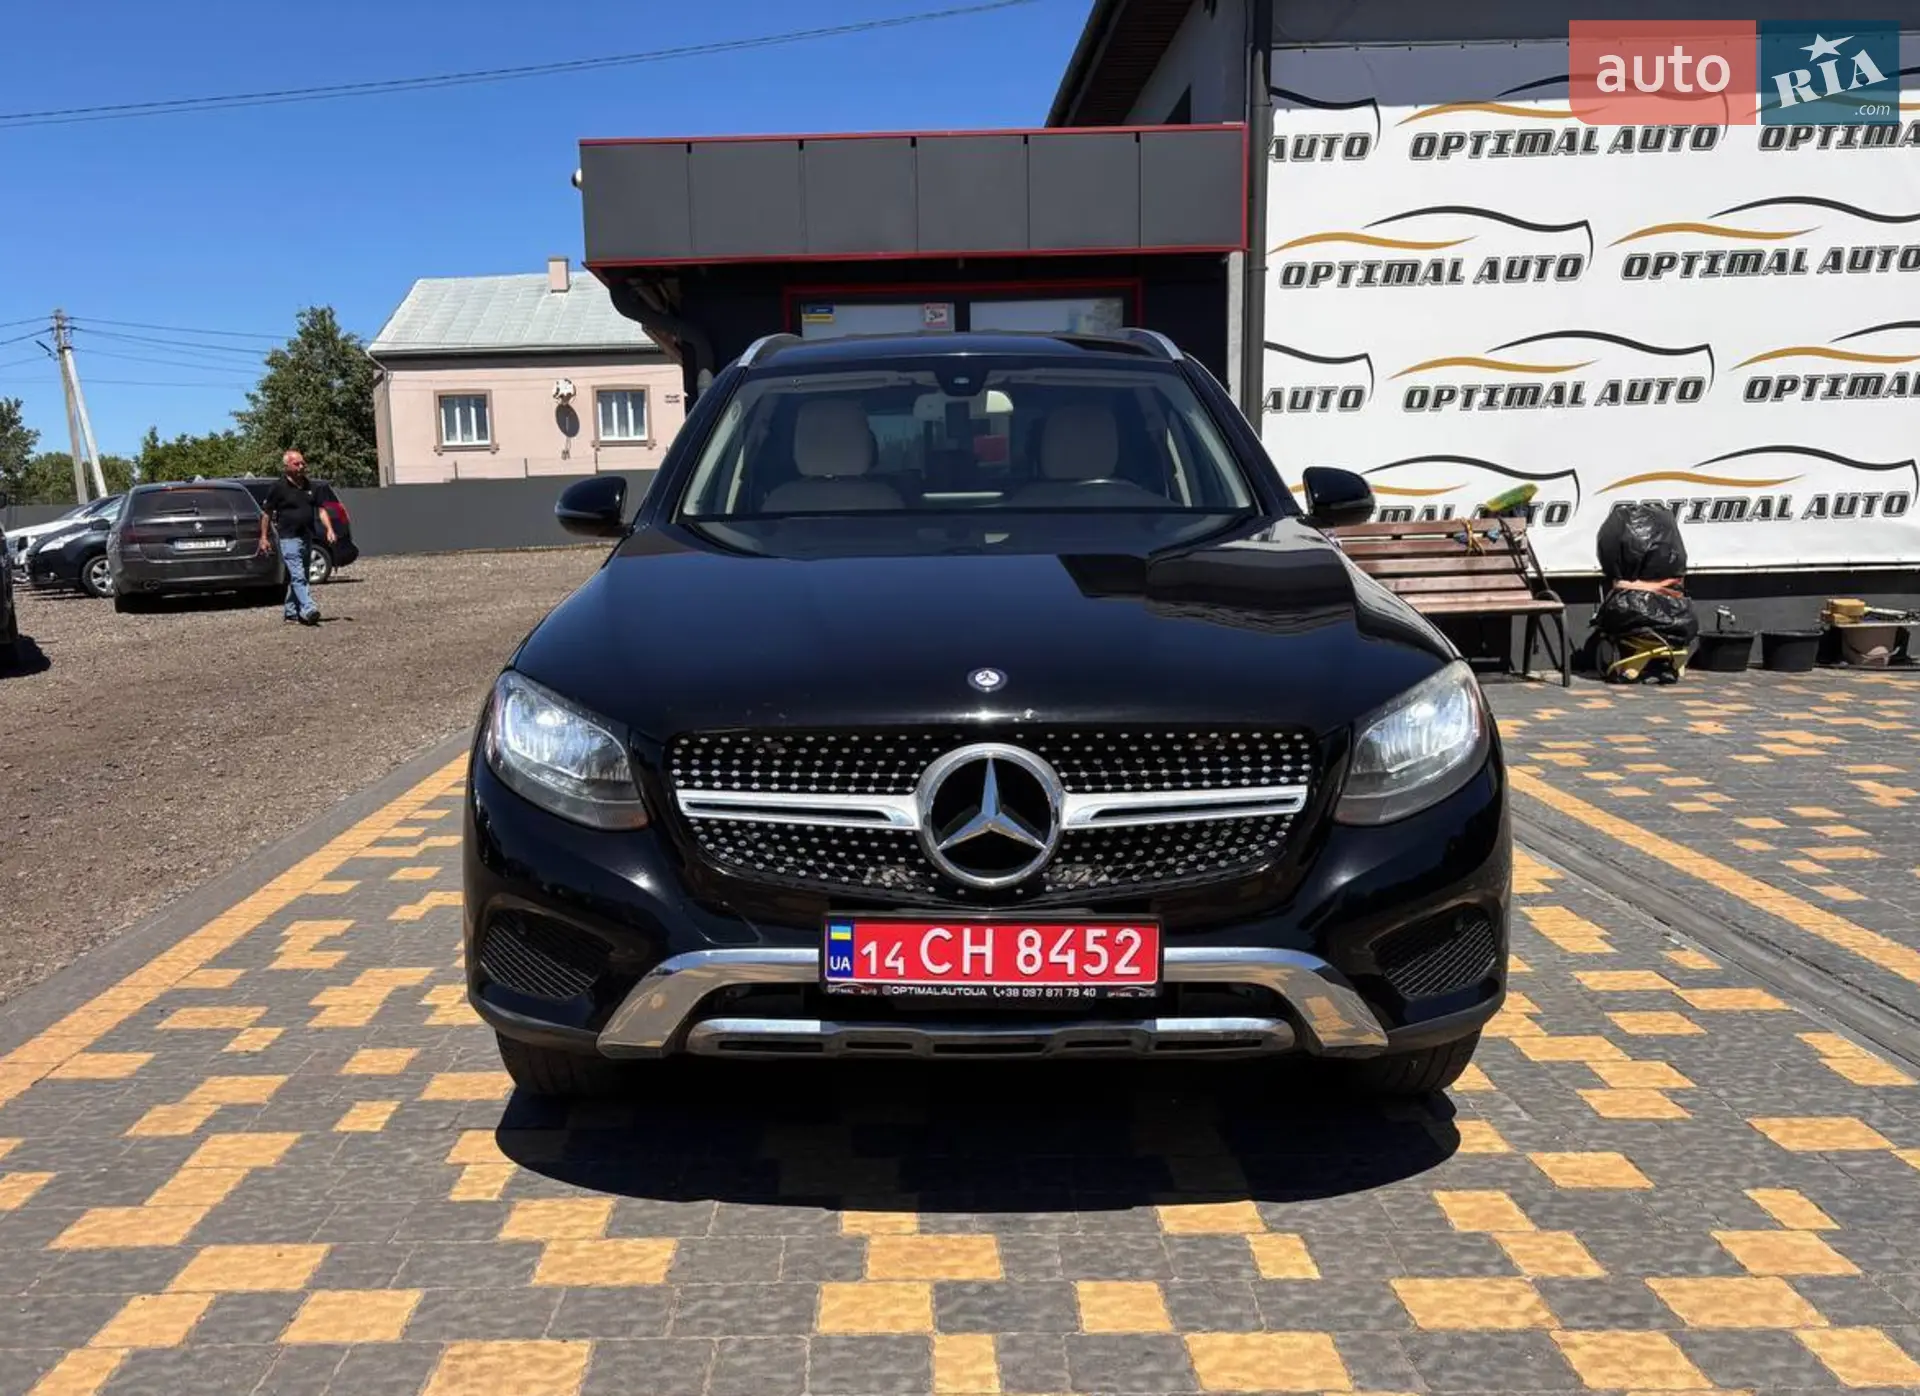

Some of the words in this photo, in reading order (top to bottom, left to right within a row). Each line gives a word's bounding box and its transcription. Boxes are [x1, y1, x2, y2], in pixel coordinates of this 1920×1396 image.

[1267, 132, 1372, 163] AUTO
[1409, 127, 1599, 161] OPTIMAL
[1607, 124, 1722, 155] AUTO
[1280, 257, 1465, 289] OPTIMAL
[1473, 253, 1586, 285] AUTO
[1621, 248, 1808, 281] OPTIMAL
[1817, 245, 1920, 275] AUTO
[1261, 385, 1367, 414] AUTO
[1402, 381, 1587, 412] OPTIMAL
[1594, 376, 1706, 406] AUTO
[1802, 490, 1911, 520] AUTO
[829, 955, 852, 972] UA
[860, 940, 905, 977] 14
[919, 927, 994, 976] CH
[1016, 928, 1143, 976] 8452
[1083, 987, 1097, 998] 40
